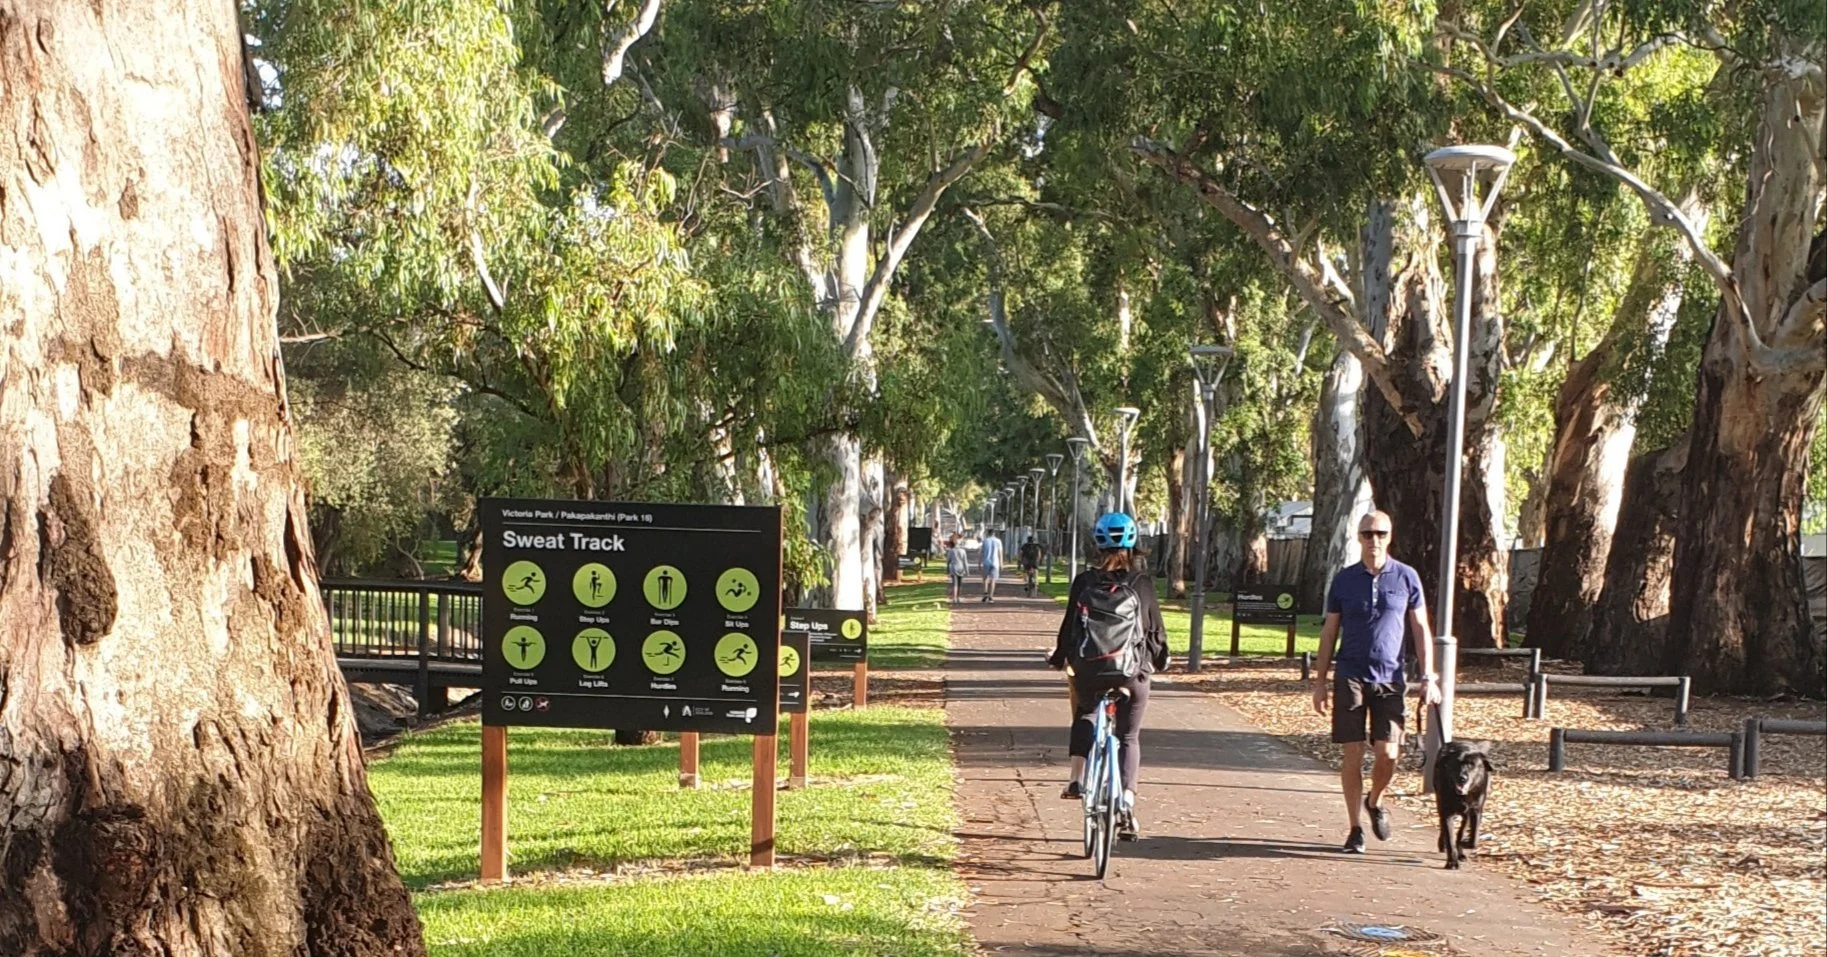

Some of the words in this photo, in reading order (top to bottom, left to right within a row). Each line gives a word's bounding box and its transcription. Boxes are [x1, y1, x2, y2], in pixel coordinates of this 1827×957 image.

[502, 509, 533, 518] Victoria
[535, 510, 554, 519] Park
[561, 511, 616, 521] Pakapakanthi
[617, 513, 639, 522] (Park
[502, 530, 565, 549] Sweat
[570, 532, 625, 551] Track
[596, 616, 610, 624] Ups
[735, 620, 750, 628] Ups
[790, 621, 810, 631] Step
[811, 621, 828, 631] Ups
[524, 678, 538, 686] Ups
[579, 680, 592, 688] Leg
[593, 680, 608, 688] Lifts
[721, 685, 750, 693] Running
